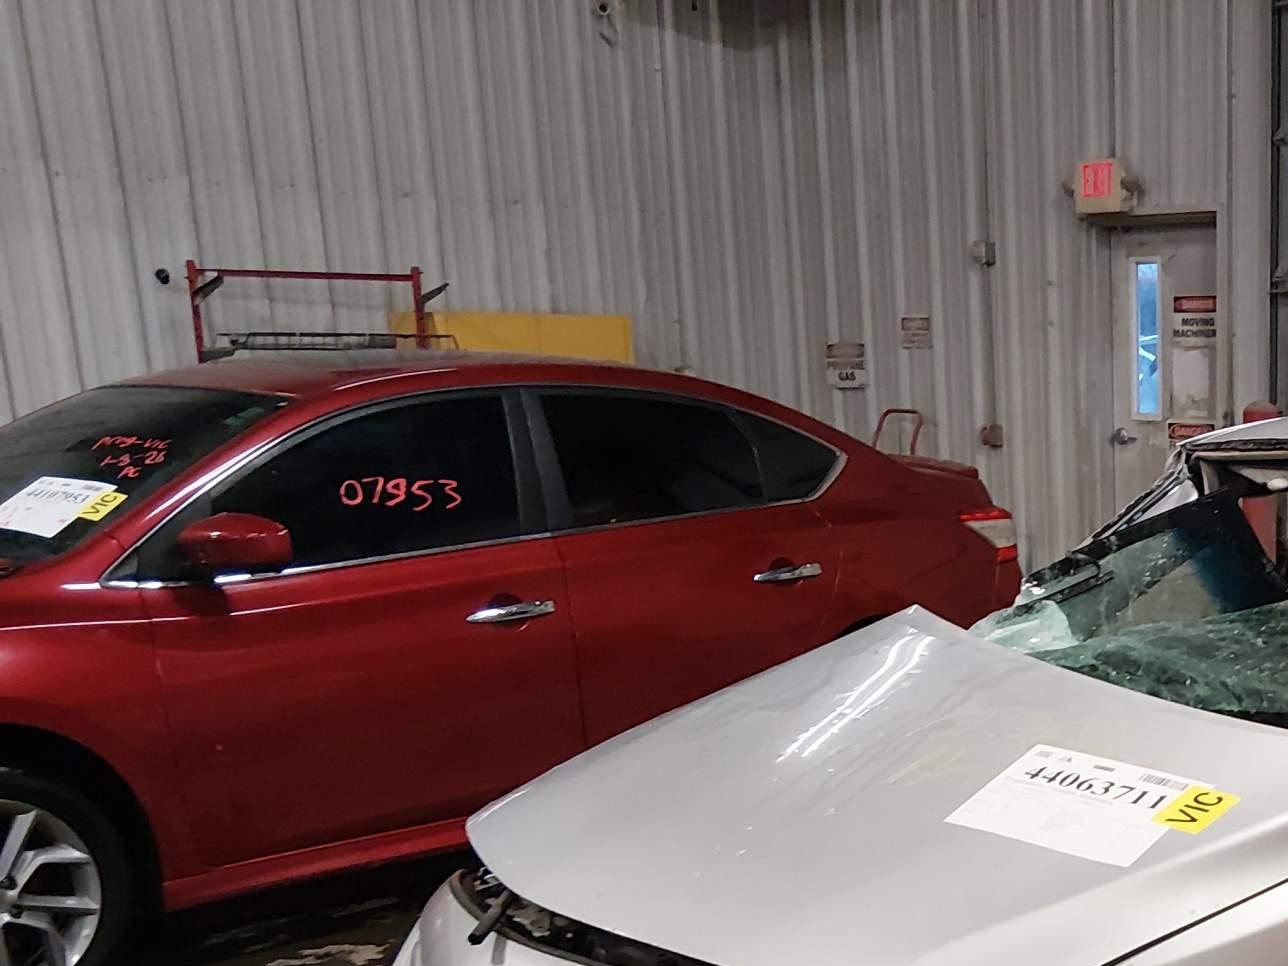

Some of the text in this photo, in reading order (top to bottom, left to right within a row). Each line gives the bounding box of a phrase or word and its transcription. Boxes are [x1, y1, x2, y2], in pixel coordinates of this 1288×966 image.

[1083, 163, 1112, 197] EXIT
[1173, 329, 1217, 338] MACHINER
[1181, 317, 1215, 327] MOVING
[838, 371, 856, 381] GAS
[81, 493, 117, 516] VIC
[339, 476, 462, 511] 07953
[1024, 766, 1168, 810] 44063711
[1165, 791, 1224, 826] VIC
